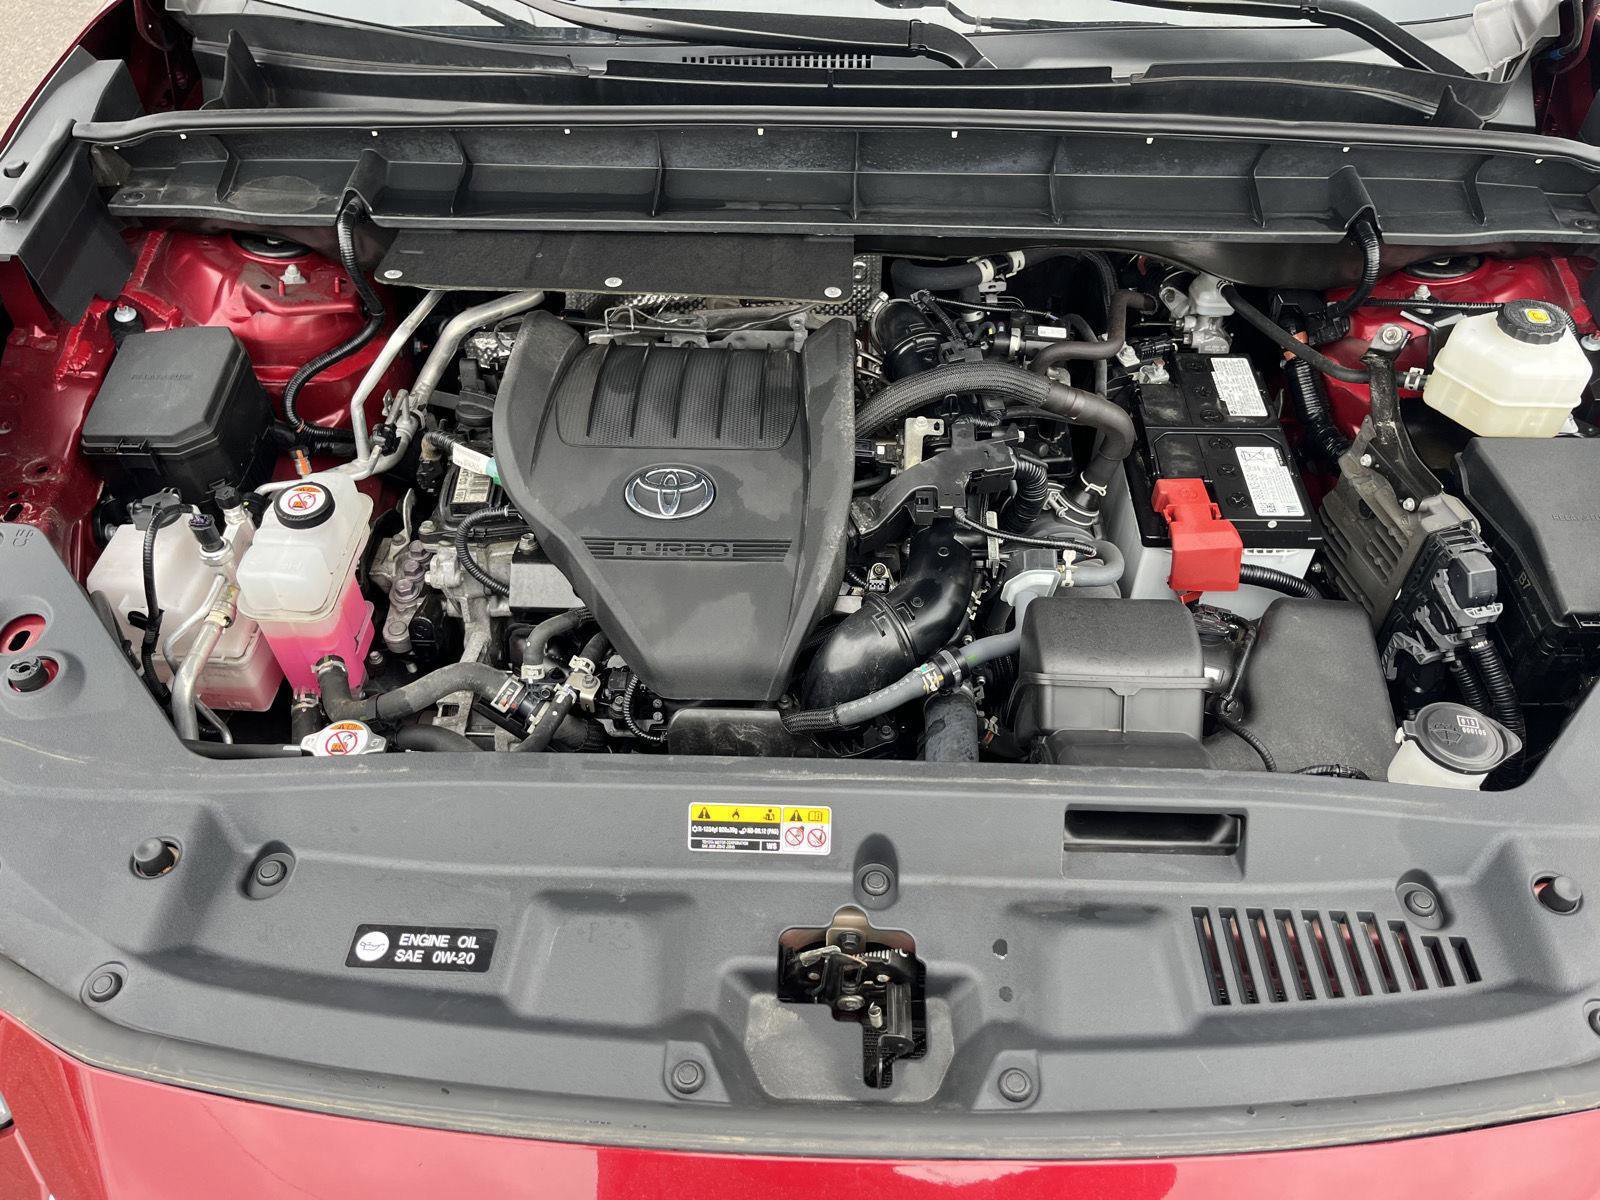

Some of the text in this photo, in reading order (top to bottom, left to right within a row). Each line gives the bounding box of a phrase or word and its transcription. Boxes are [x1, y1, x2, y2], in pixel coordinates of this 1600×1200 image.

[617, 541, 730, 557] TURBO
[398, 933, 480, 949] ENGINE OIL
[394, 949, 476, 965] SAE 0W-20
